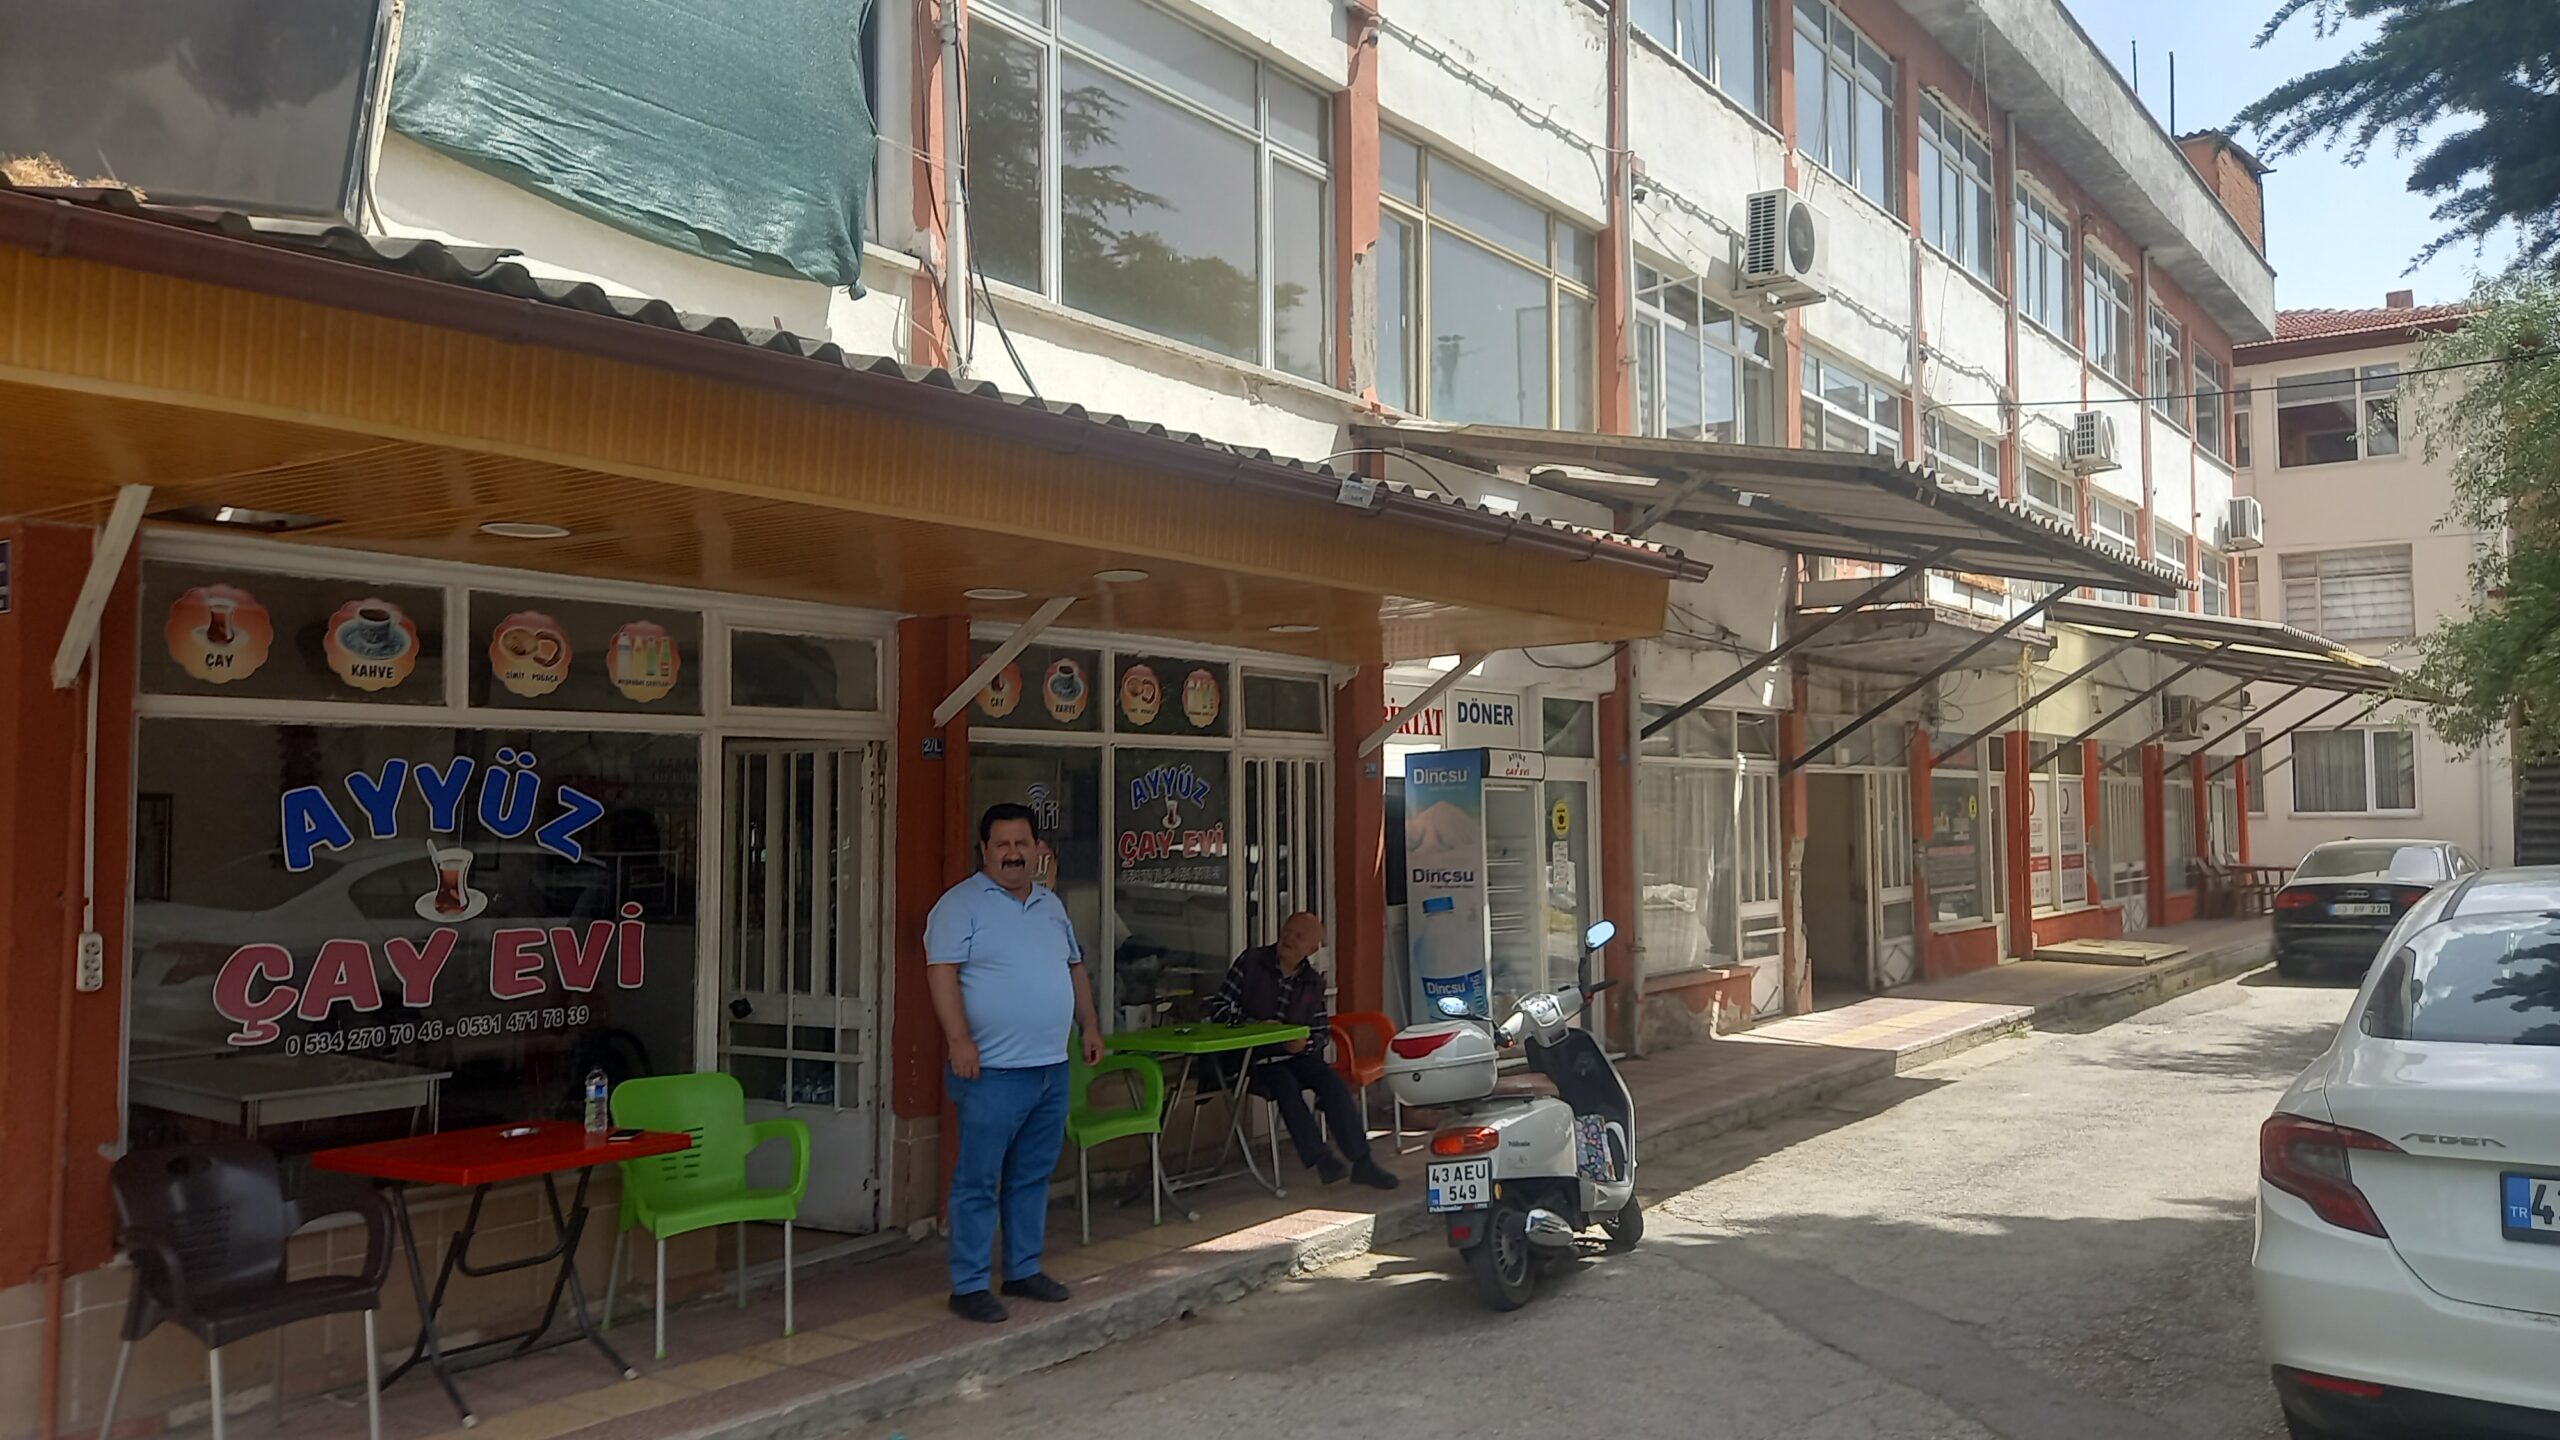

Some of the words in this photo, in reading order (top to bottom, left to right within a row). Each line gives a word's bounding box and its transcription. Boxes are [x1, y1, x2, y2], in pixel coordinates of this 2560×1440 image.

[205, 653, 235, 670] ÇAY
[351, 664, 394, 679] KAHVE
[1457, 698, 1515, 727] DÖNER
[1131, 763, 1211, 810] AYYÜZ
[282, 747, 604, 872] AYYÜZ
[1118, 830, 1175, 868] ÇAY
[1183, 821, 1224, 858] EVİ
[1412, 868, 1474, 885] Dinçsu
[213, 927, 459, 1047] ÇAY
[490, 902, 646, 1000] EVİ
[285, 1038, 299, 1057] 0
[304, 1030, 345, 1055] 534
[347, 1026, 386, 1050] 270
[389, 1023, 415, 1045] 70
[417, 1020, 443, 1042] 46
[457, 1014, 503, 1037] 0531
[505, 1010, 538, 1032] 471
[542, 1007, 565, 1028] 78
[566, 1005, 590, 1025] 39
[1431, 1167, 1450, 1184] 43
[1453, 1163, 1487, 1181] AEU
[1449, 1184, 1478, 1202] 549
[2531, 1183, 2560, 1225] 4
[2510, 1205, 2529, 1219] TR
